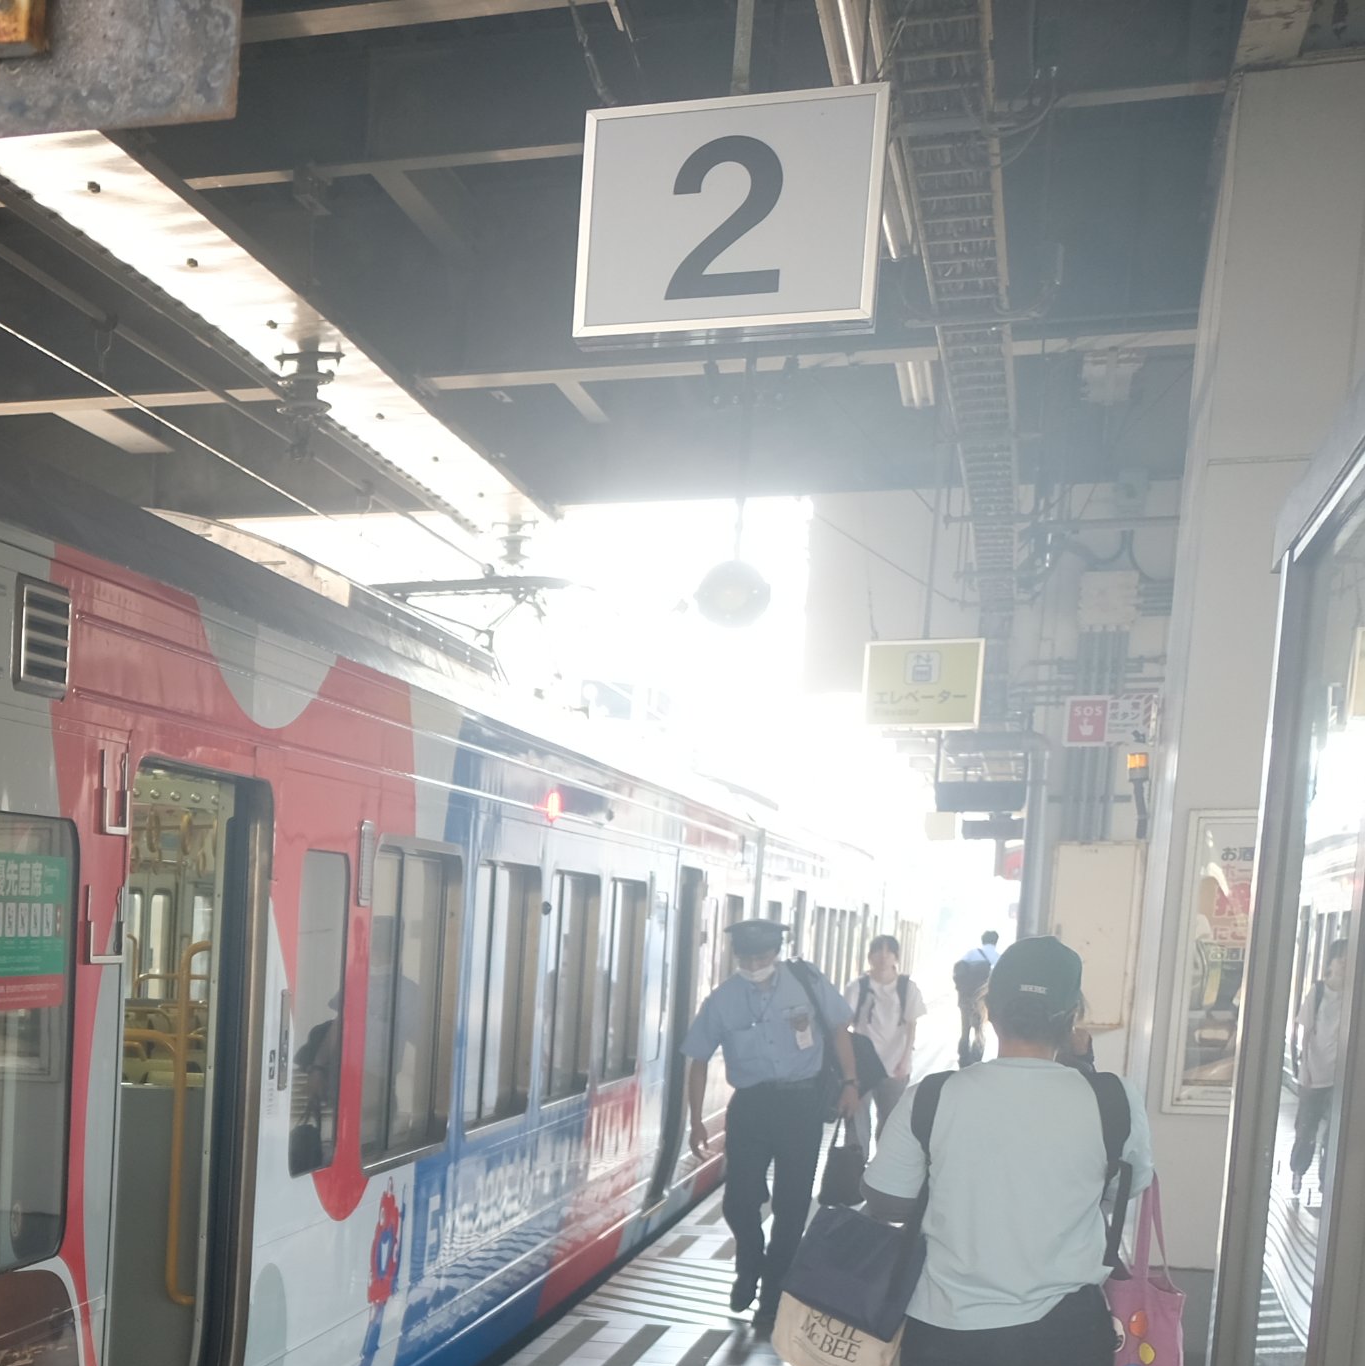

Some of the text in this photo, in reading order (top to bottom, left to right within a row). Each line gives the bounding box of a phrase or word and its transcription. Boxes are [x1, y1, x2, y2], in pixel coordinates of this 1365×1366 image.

[663, 134, 784, 300] 2
[873, 689, 968, 704] エレベーター
[1073, 705, 1103, 717] SOS
